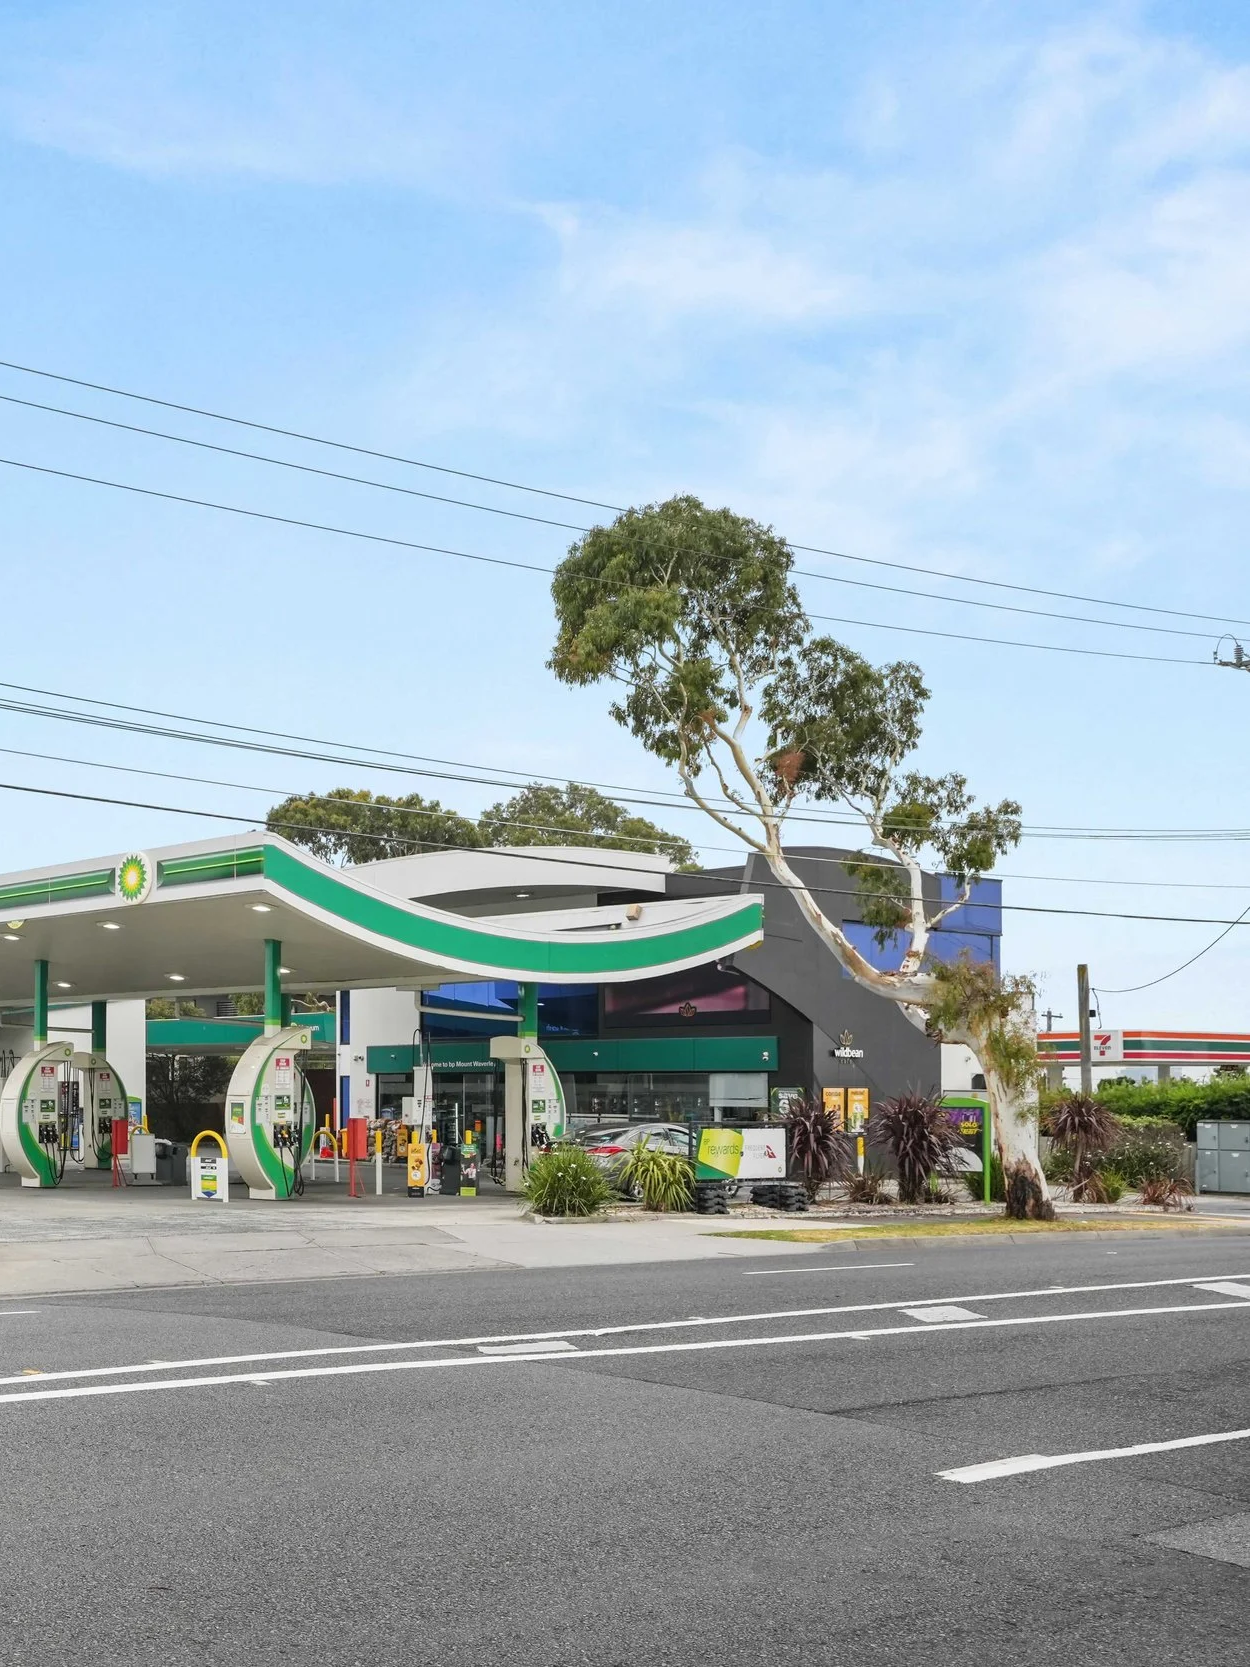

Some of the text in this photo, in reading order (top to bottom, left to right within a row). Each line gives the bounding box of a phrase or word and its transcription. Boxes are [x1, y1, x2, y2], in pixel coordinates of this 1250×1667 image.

[834, 1046, 864, 1059] wildbean
[449, 1061, 456, 1069] bp
[456, 1060, 473, 1068] Mount
[778, 1092, 799, 1100] save
[707, 1143, 740, 1156] rewards
